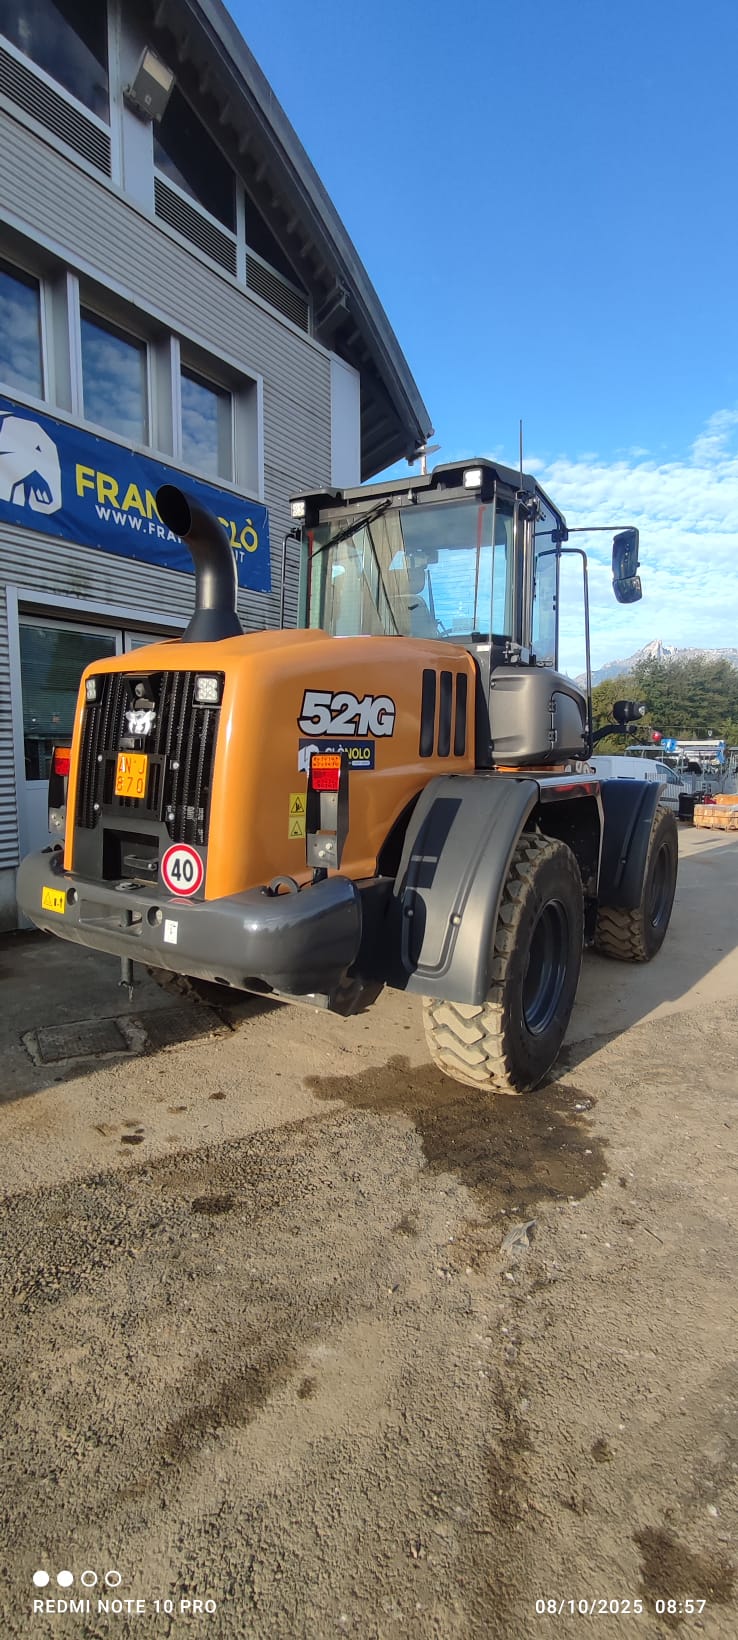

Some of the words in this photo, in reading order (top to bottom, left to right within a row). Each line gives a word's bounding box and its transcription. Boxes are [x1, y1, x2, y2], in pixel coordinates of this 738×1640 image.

[298, 690, 396, 737] 521G
[116, 775, 144, 794] 870
[171, 858, 194, 882] 40
